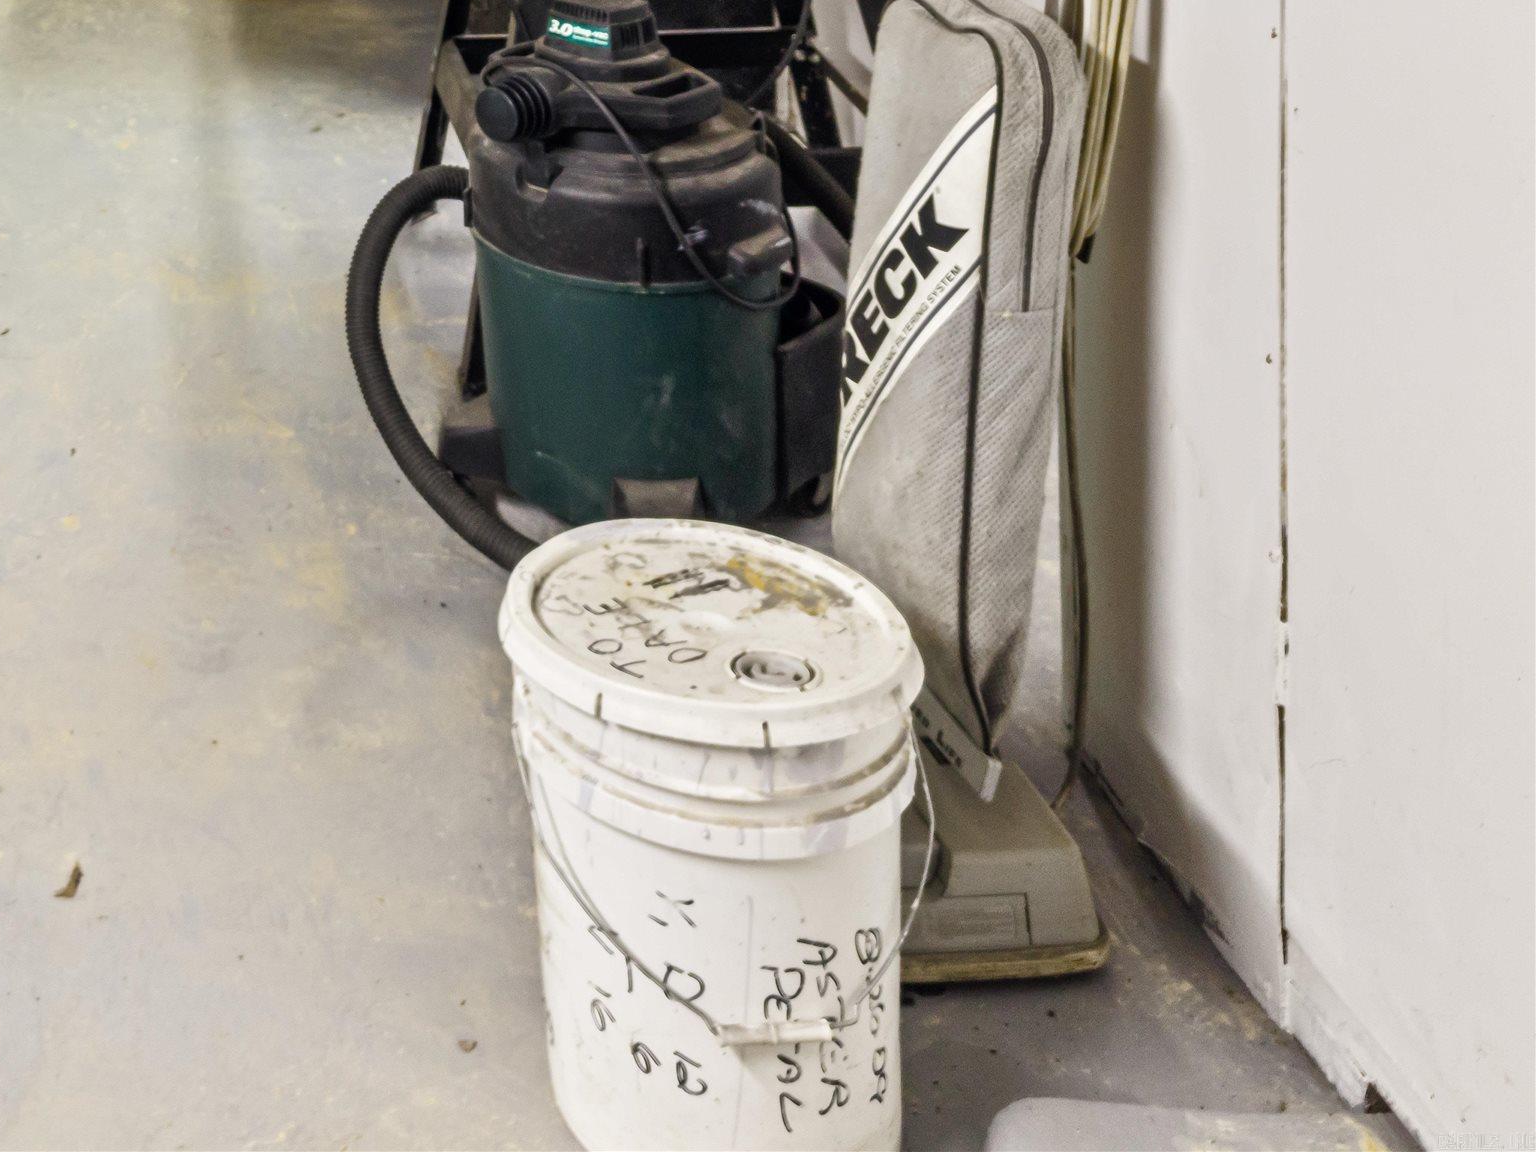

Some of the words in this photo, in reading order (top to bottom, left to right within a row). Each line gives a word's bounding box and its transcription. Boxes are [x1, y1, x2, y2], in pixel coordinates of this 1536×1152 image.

[895, 303, 929, 347] FILTERING
[926, 263, 962, 305] SYSTEM
[760, 965, 806, 1133] PEAL
